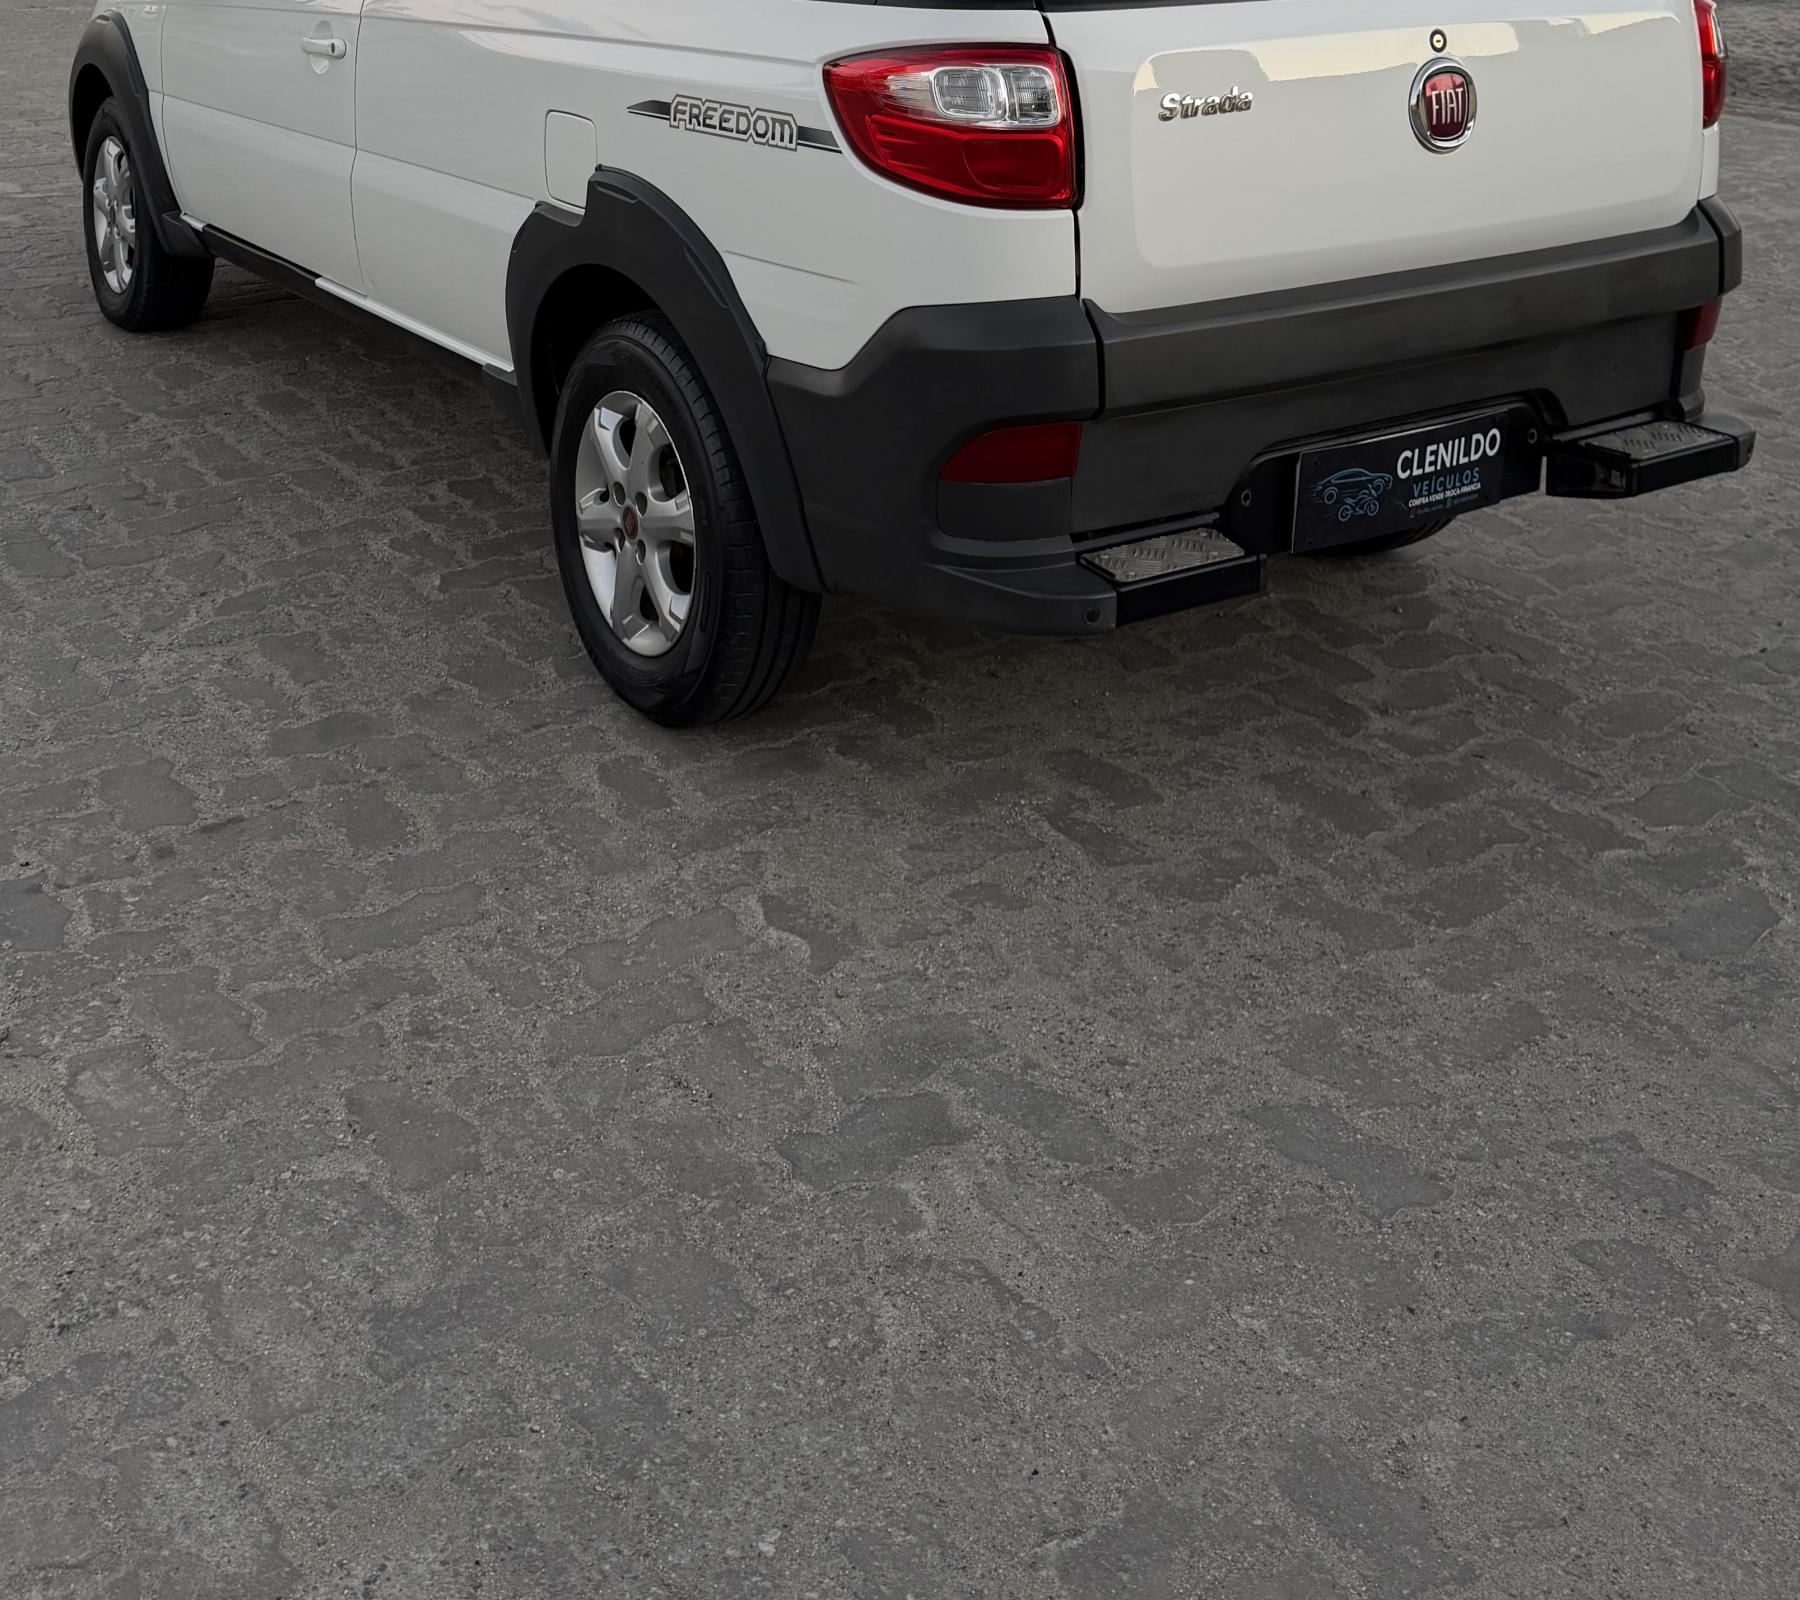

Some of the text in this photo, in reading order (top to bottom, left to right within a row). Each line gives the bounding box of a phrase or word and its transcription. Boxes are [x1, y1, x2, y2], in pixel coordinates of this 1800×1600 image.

[1158, 85, 1254, 121] Strada
[1431, 87, 1464, 125] FIAT
[670, 97, 797, 149] FREEDOM
[1397, 428, 1501, 479] CLENILDO
[1413, 467, 1480, 497] VEÍCULOS
